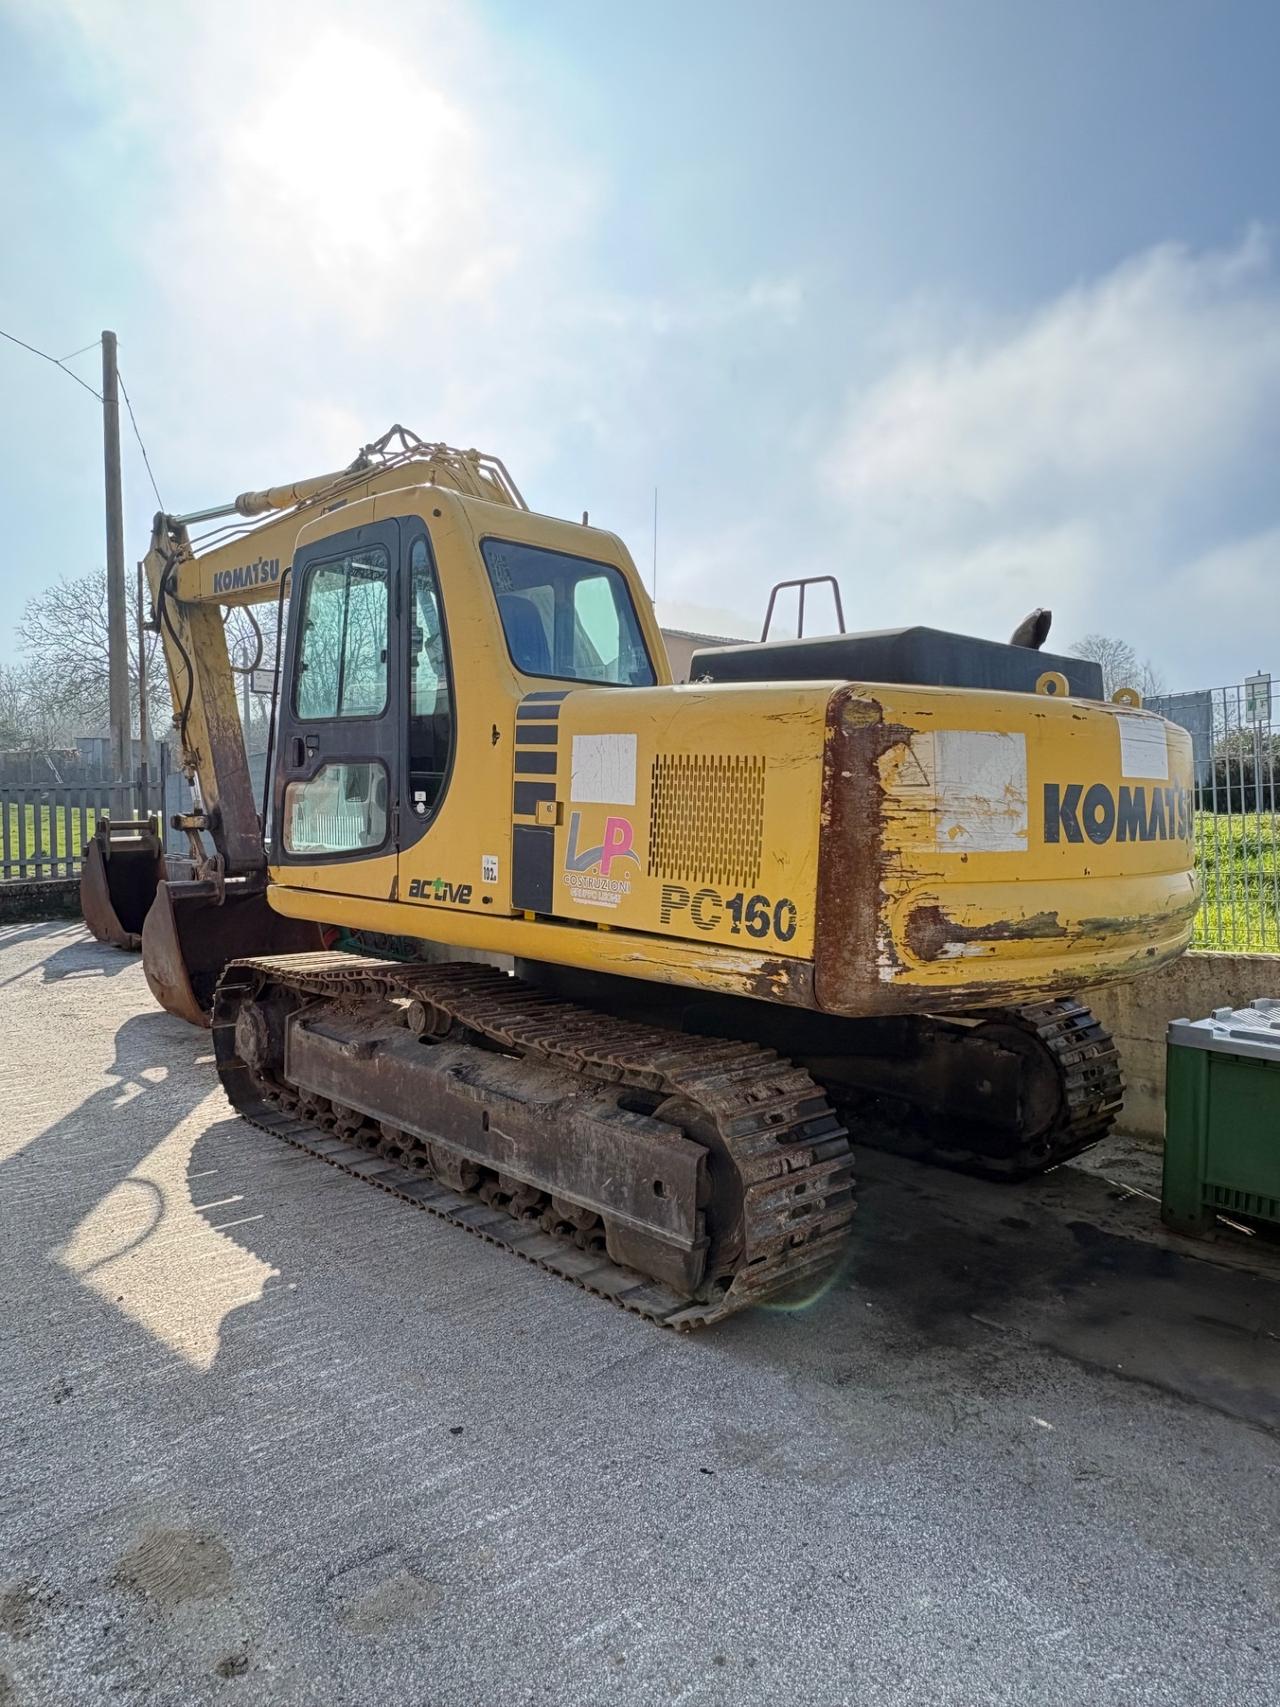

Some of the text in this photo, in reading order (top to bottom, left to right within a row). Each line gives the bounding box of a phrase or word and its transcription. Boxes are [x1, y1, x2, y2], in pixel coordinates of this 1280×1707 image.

[213, 556, 280, 593] KOMATSU
[408, 877, 473, 904] active
[659, 884, 797, 942] PC160
